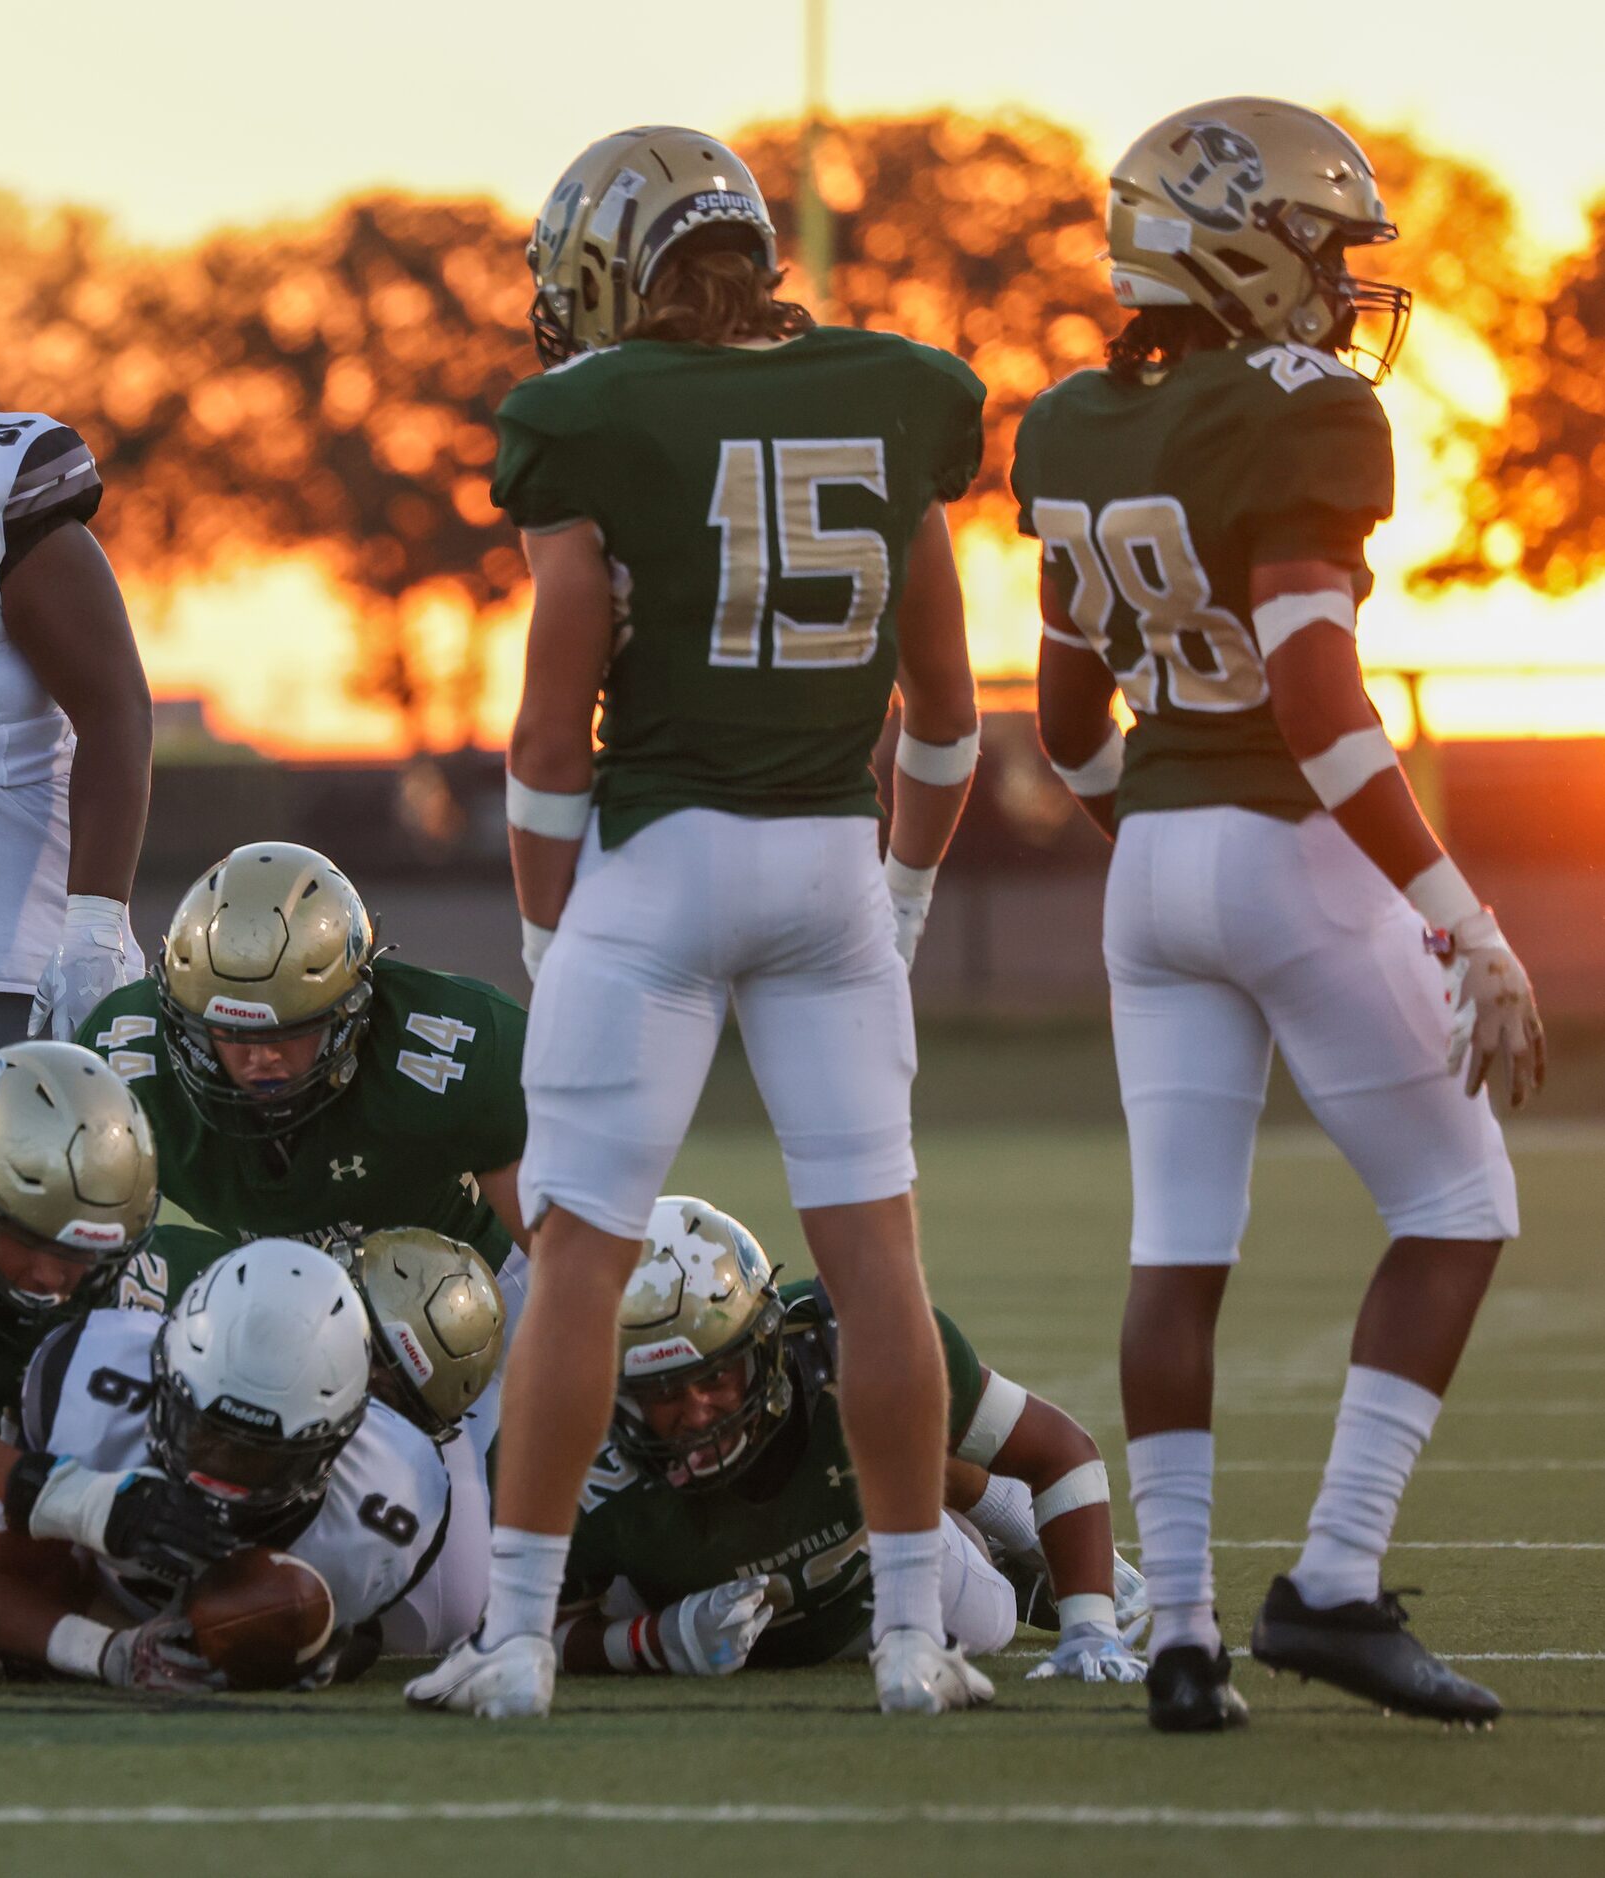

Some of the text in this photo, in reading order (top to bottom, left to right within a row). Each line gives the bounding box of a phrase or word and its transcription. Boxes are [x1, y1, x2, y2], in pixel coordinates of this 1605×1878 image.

[1244, 343, 1359, 394] 2
[707, 437, 890, 669] 15
[1032, 496, 1270, 715] 28
[214, 1003, 267, 1020] Riddell
[95, 1014, 157, 1085] 44
[180, 1036, 218, 1074] Riddell
[396, 1012, 476, 1094] 44
[219, 1398, 276, 1427] Riddell
